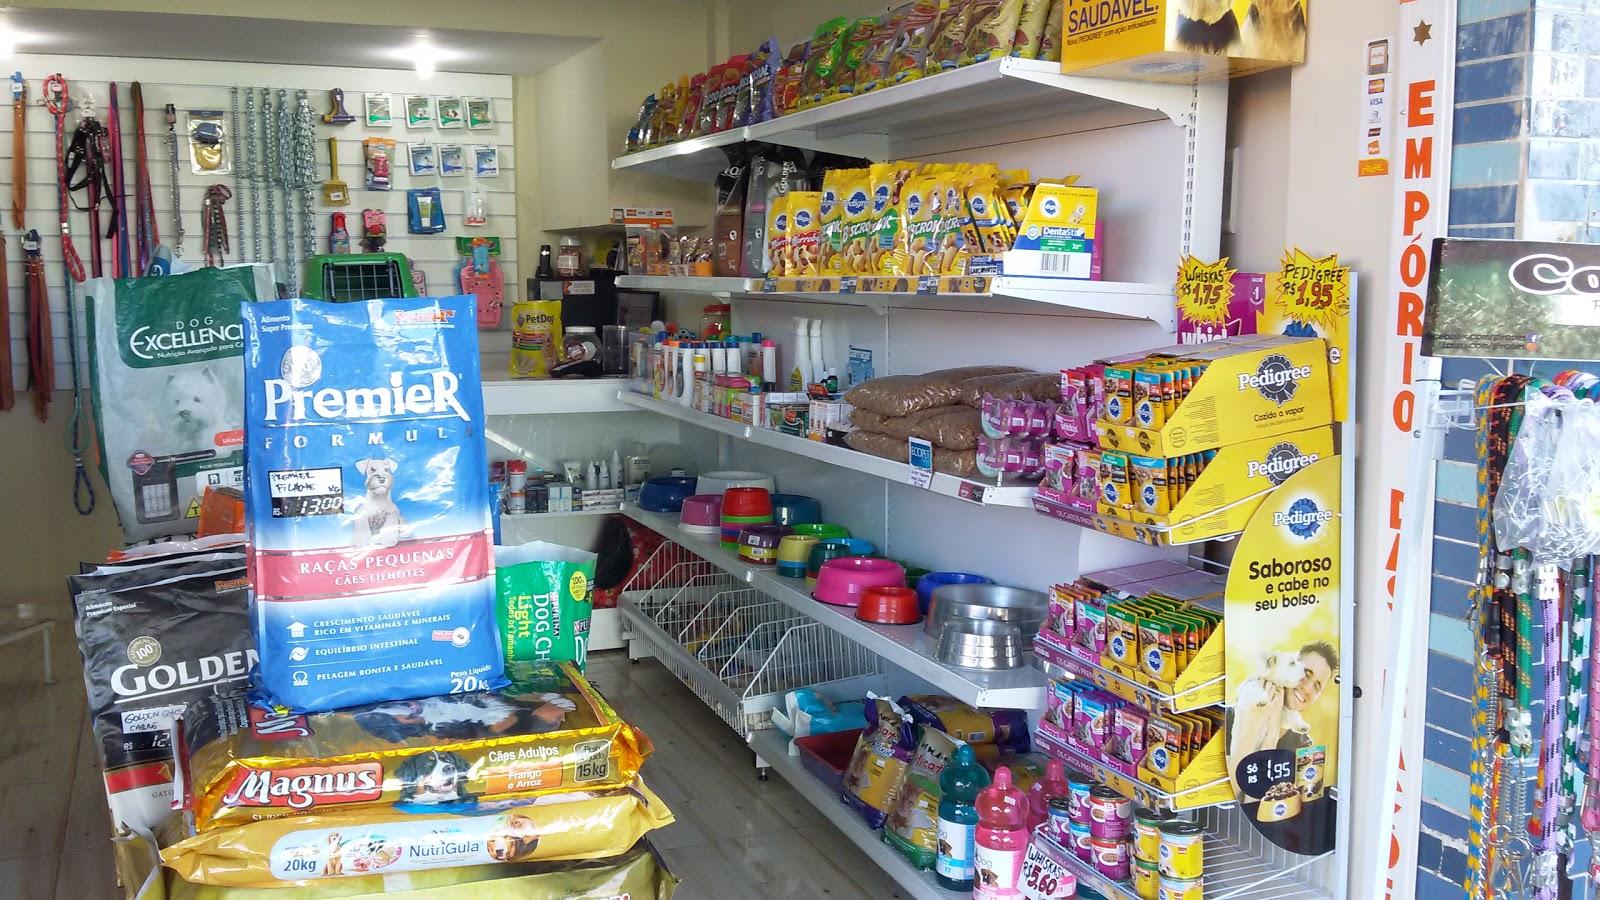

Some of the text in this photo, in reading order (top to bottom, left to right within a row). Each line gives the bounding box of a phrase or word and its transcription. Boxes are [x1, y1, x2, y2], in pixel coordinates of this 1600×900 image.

[1369, 97, 1384, 106] VISA
[1284, 264, 1344, 283] PEDIGREE
[1193, 283, 1224, 306] 1,75
[1284, 281, 1296, 296] R$
[1296, 281, 1334, 307] 1,95
[176, 316, 213, 330] DOG
[261, 325, 282, 333] Super
[1238, 364, 1312, 391] Pedigree
[1247, 452, 1320, 478] Pedigree
[1273, 509, 1333, 527] Pedigree
[300, 548, 454, 577] RAÇAS PEQUENAS
[1249, 556, 1332, 580] Saboroso
[335, 567, 425, 586] CÃES FILHOTES
[1265, 576, 1330, 594] e cabe no
[1255, 592, 1320, 611] seu bolso.
[313, 610, 421, 628] CRESCIMENTO SAUDÁVEL
[514, 595, 533, 638] Light
[533, 594, 550, 632] DOG
[314, 628, 336, 637] RICO
[339, 626, 352, 635] EM
[355, 621, 402, 632] VITAMINAS
[411, 614, 451, 625] MINERAIS
[315, 638, 419, 656] EQUILÍBRIO INTESTINAL
[316, 670, 357, 681] PELAGEM
[359, 667, 393, 676] BONITA
[401, 658, 444, 671] SAUDÁVEL
[488, 745, 560, 763] Cães Adultos
[508, 769, 542, 781] Frango
[576, 762, 608, 778] 15kg
[222, 768, 377, 809] Magnus
[517, 778, 543, 789] Arroz
[409, 841, 479, 858] NutriGula
[283, 857, 317, 873] 20kg
[1027, 864, 1058, 896] 5,60
